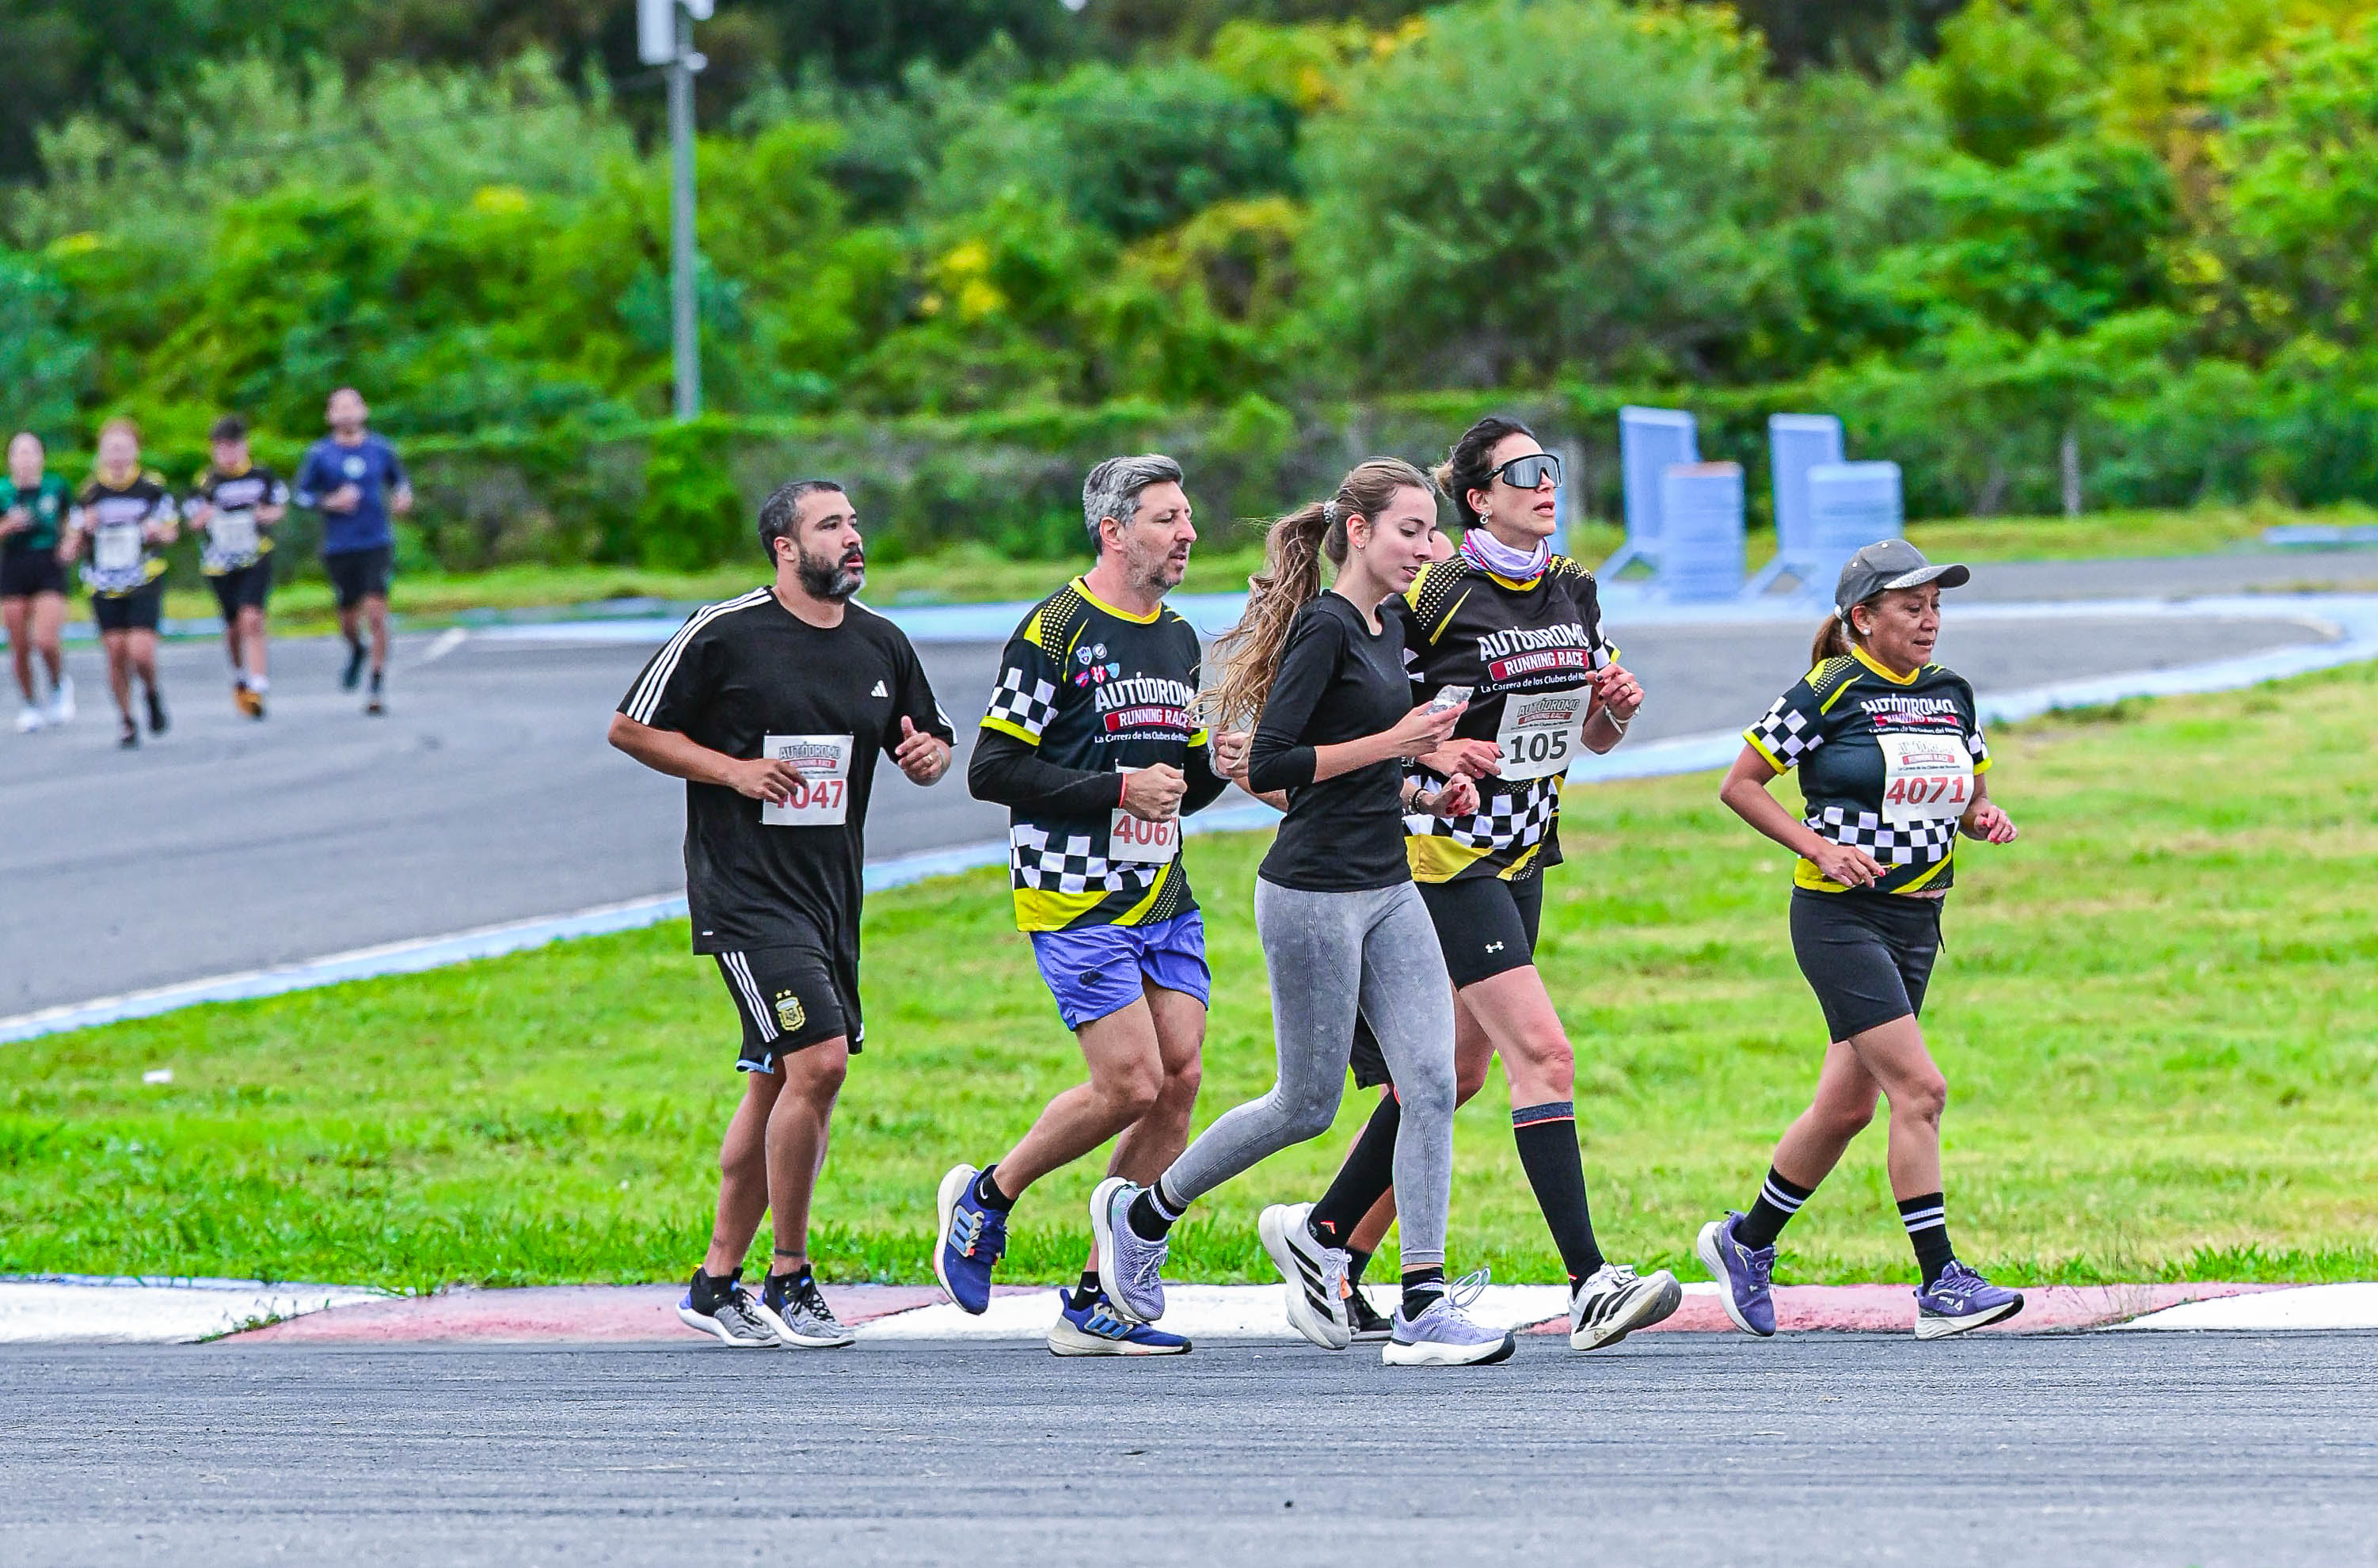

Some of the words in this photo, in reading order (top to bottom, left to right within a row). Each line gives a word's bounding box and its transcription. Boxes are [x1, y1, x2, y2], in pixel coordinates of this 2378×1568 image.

[1476, 623, 1590, 661] AUTÓDROMO
[1504, 652, 1556, 676] RUNNING
[1558, 651, 1585, 666] RACE
[1095, 671, 1195, 713] AUTÓDROM
[1481, 685, 1491, 694] La
[1492, 682, 1521, 691] Carrera
[1522, 678, 1532, 687] de
[1533, 676, 1543, 686] los
[1544, 674, 1567, 684] Clubes
[1568, 672, 1578, 682] del
[1118, 708, 1162, 727] RUNNING
[1517, 698, 1581, 718] AUTÓDROMO
[1094, 735, 1105, 744] La
[1132, 731, 1142, 740] de
[1143, 730, 1152, 740] los
[1509, 729, 1568, 765] 105
[779, 740, 842, 761] AUTÓDROMO
[1885, 775, 1966, 805] 4071
[1113, 815, 1178, 847] 4067
